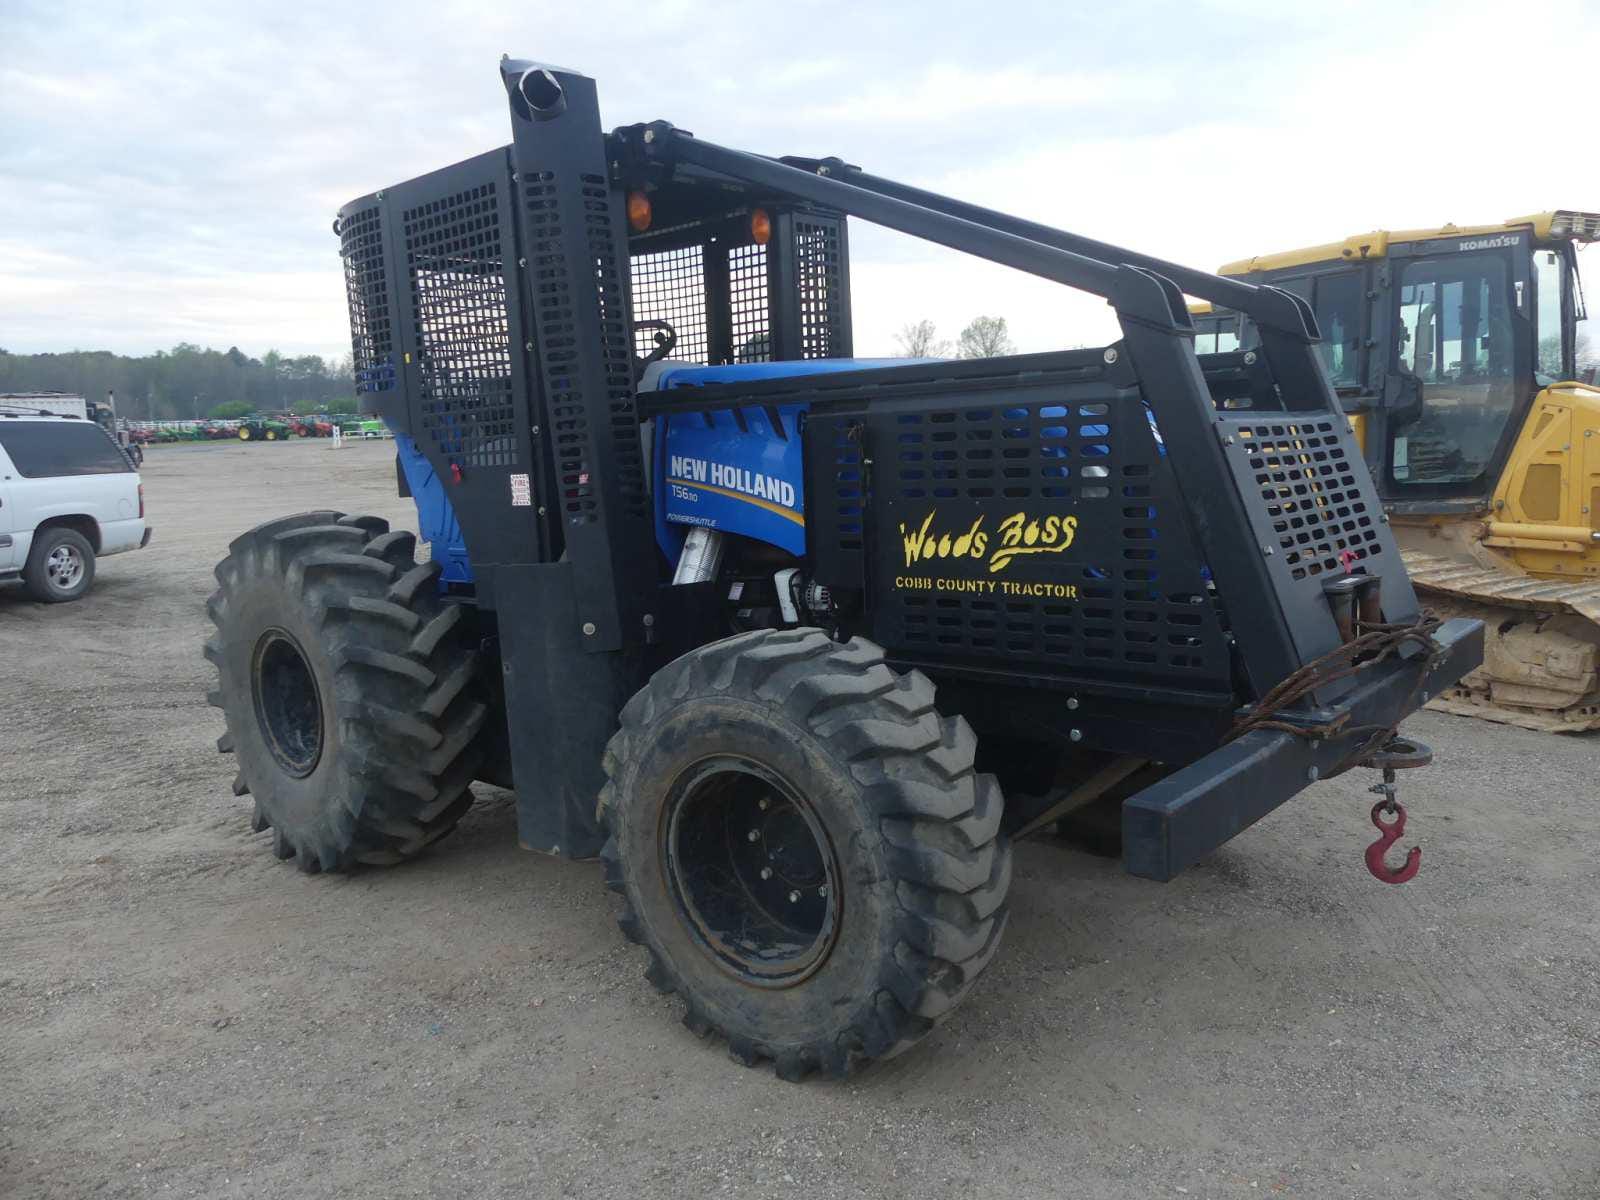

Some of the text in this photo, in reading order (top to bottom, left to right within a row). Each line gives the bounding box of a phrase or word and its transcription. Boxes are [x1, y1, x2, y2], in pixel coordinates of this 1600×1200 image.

[1459, 235, 1520, 251] KOMATSU
[671, 455, 795, 508] NEW HOLLAND
[900, 506, 988, 568] Woods
[895, 576, 1077, 598] COBB COUNTY TRACTOR
